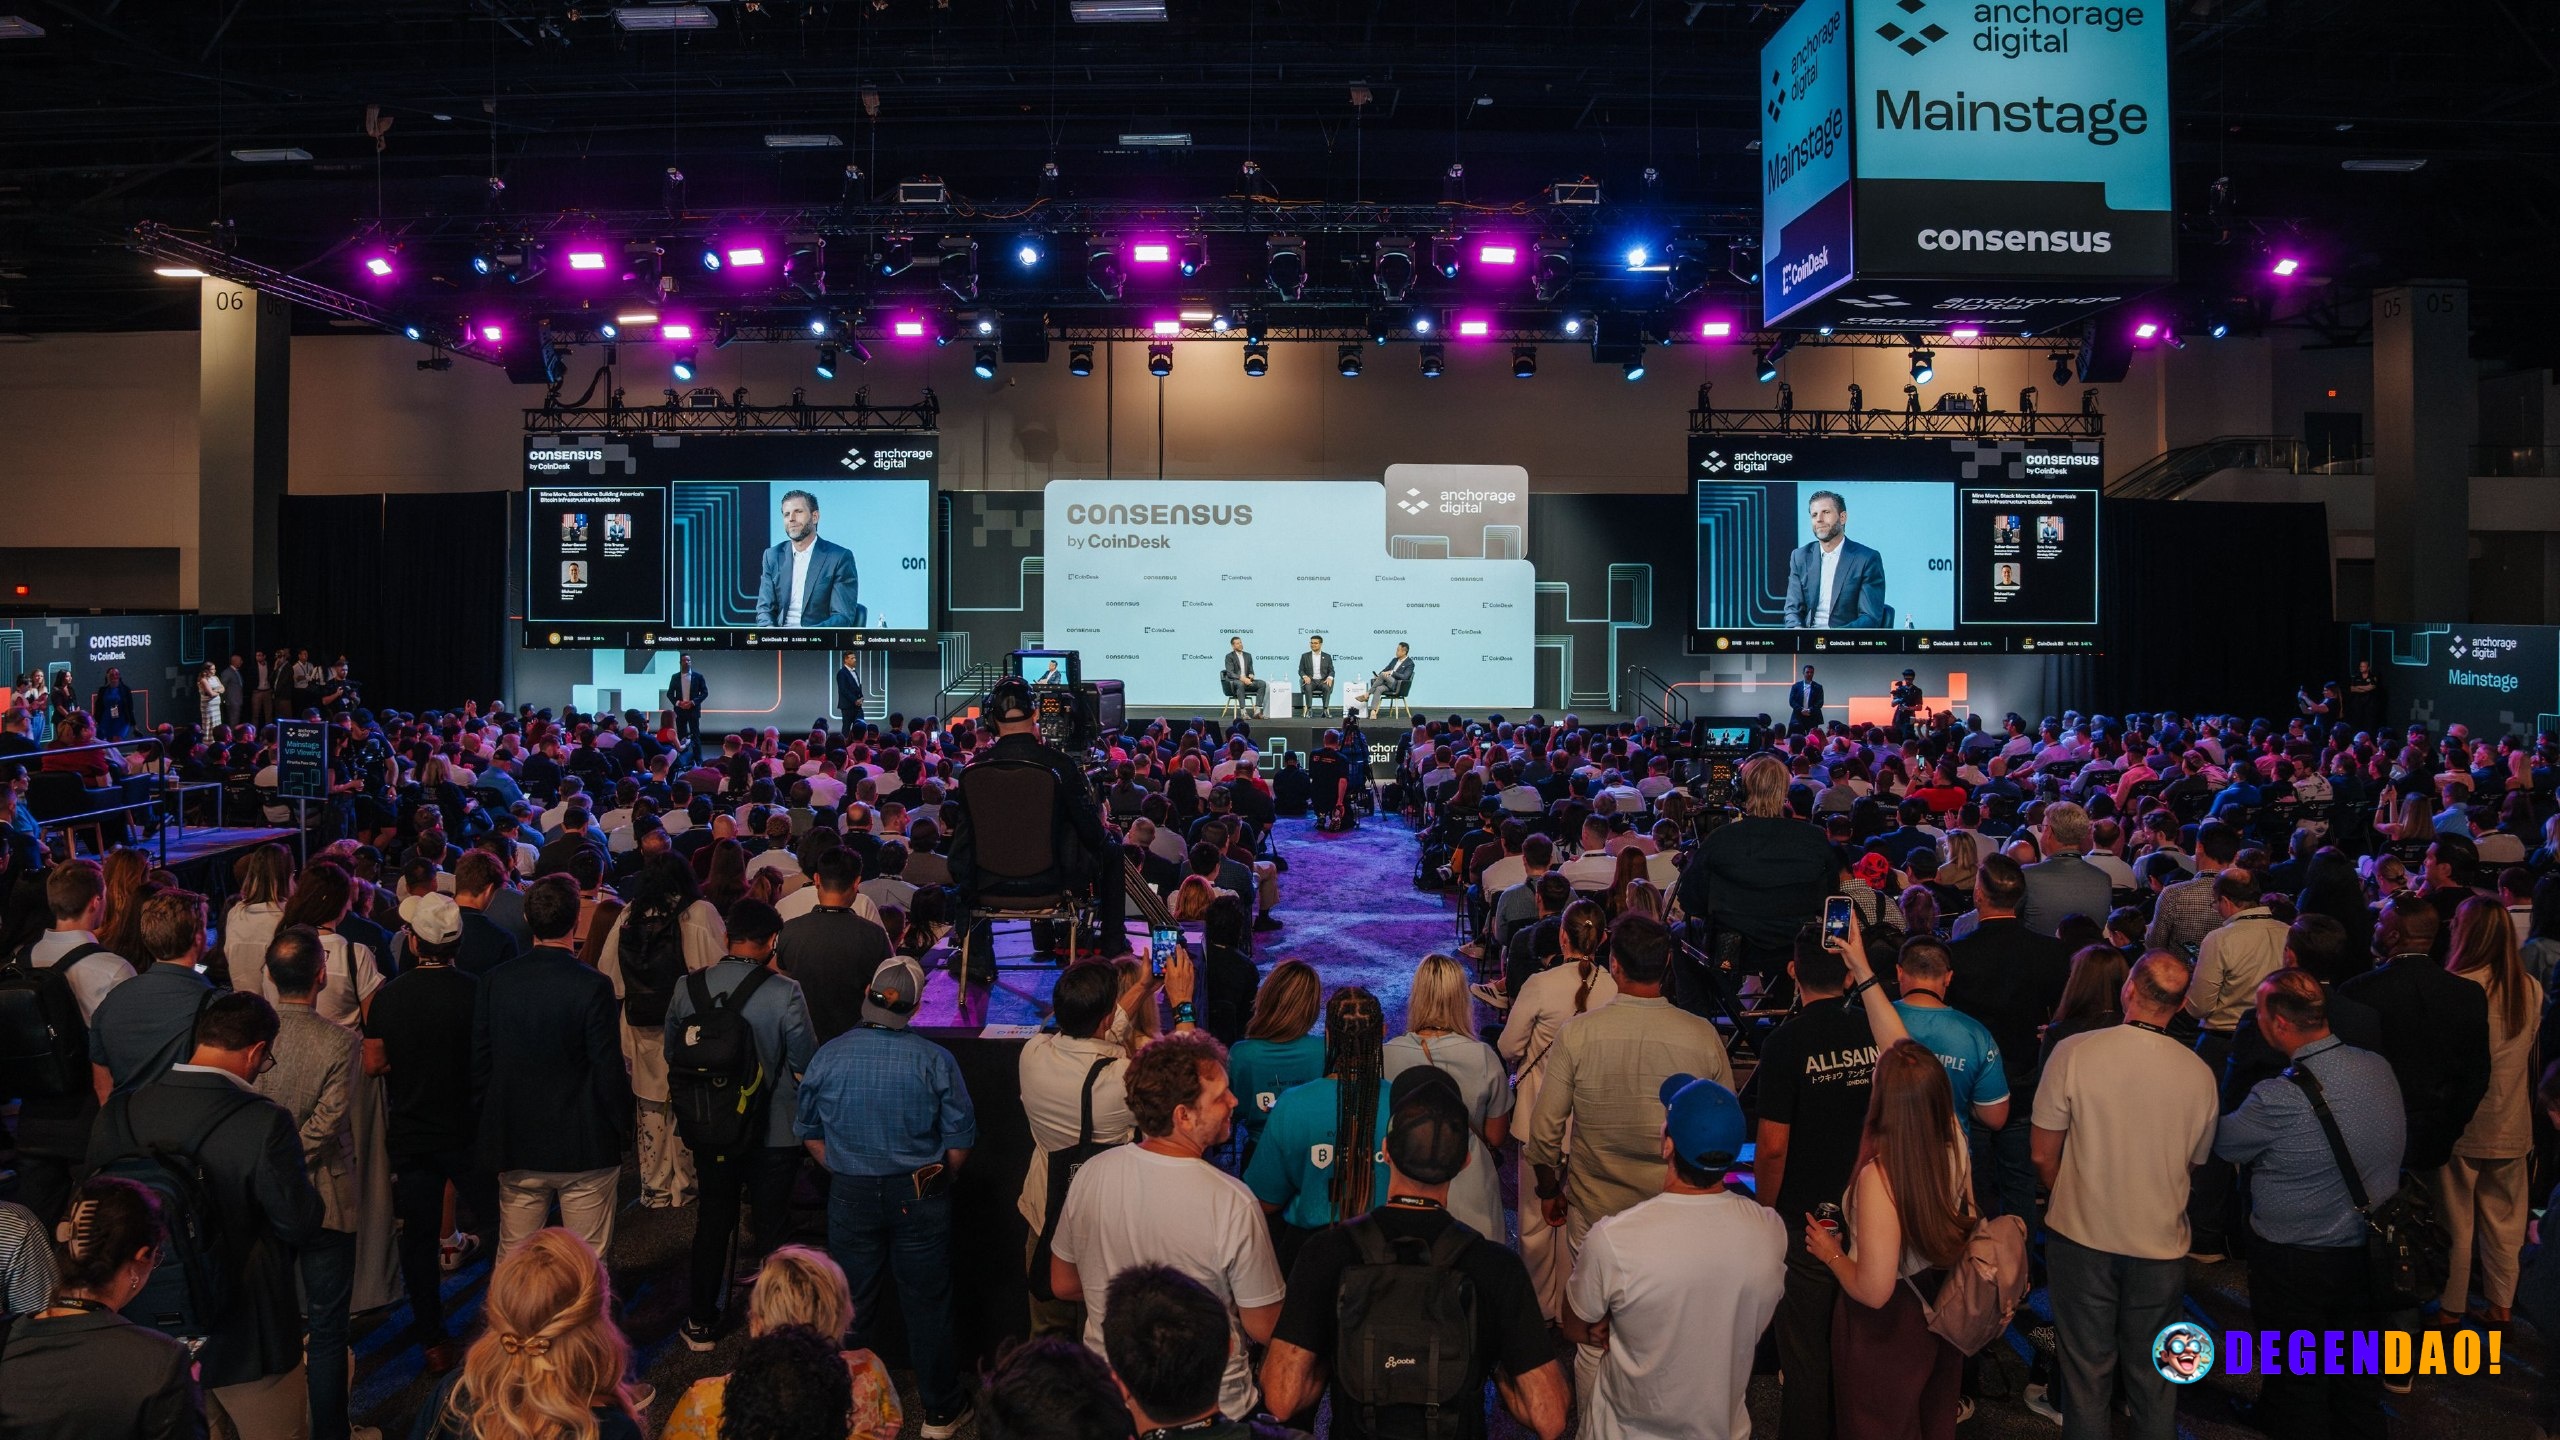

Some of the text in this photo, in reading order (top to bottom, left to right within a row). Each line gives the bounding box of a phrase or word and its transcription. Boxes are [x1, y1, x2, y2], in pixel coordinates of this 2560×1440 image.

[1973, 0, 2144, 33] anchorage
[1791, 11, 1841, 75] anchorage
[1973, 26, 2069, 59] digital
[1791, 55, 1818, 101] digital
[1876, 90, 2148, 146] Mainstage
[1768, 107, 1843, 196] Mainstage
[1917, 225, 2112, 254] consensus
[1791, 245, 1829, 286] CoinDesk
[216, 291, 243, 311] 06
[2384, 297, 2401, 319] 05
[2427, 293, 2454, 313] 05
[874, 448, 933, 461] anchorage
[1734, 451, 1793, 464] anchorage
[529, 463, 537, 471] by
[874, 457, 907, 470] digital
[1733, 460, 1767, 473] digital
[2026, 466, 2068, 476] by CoinDesk
[1440, 489, 1516, 504] anchorage
[1439, 501, 1482, 516] digital
[1067, 533, 1171, 550] by CoinDesk
[2472, 636, 2517, 650] anchorage
[90, 651, 126, 661] by CoinDesk
[2472, 647, 2497, 661] digital
[2449, 669, 2518, 693] Mainstage
[286, 740, 320, 750] Mainstage
[297, 749, 321, 758] Viewing
[1368, 753, 1390, 764] gital
[1805, 1045, 1880, 1074] ALLSAIN
[1934, 1053, 1966, 1072] MPLE
